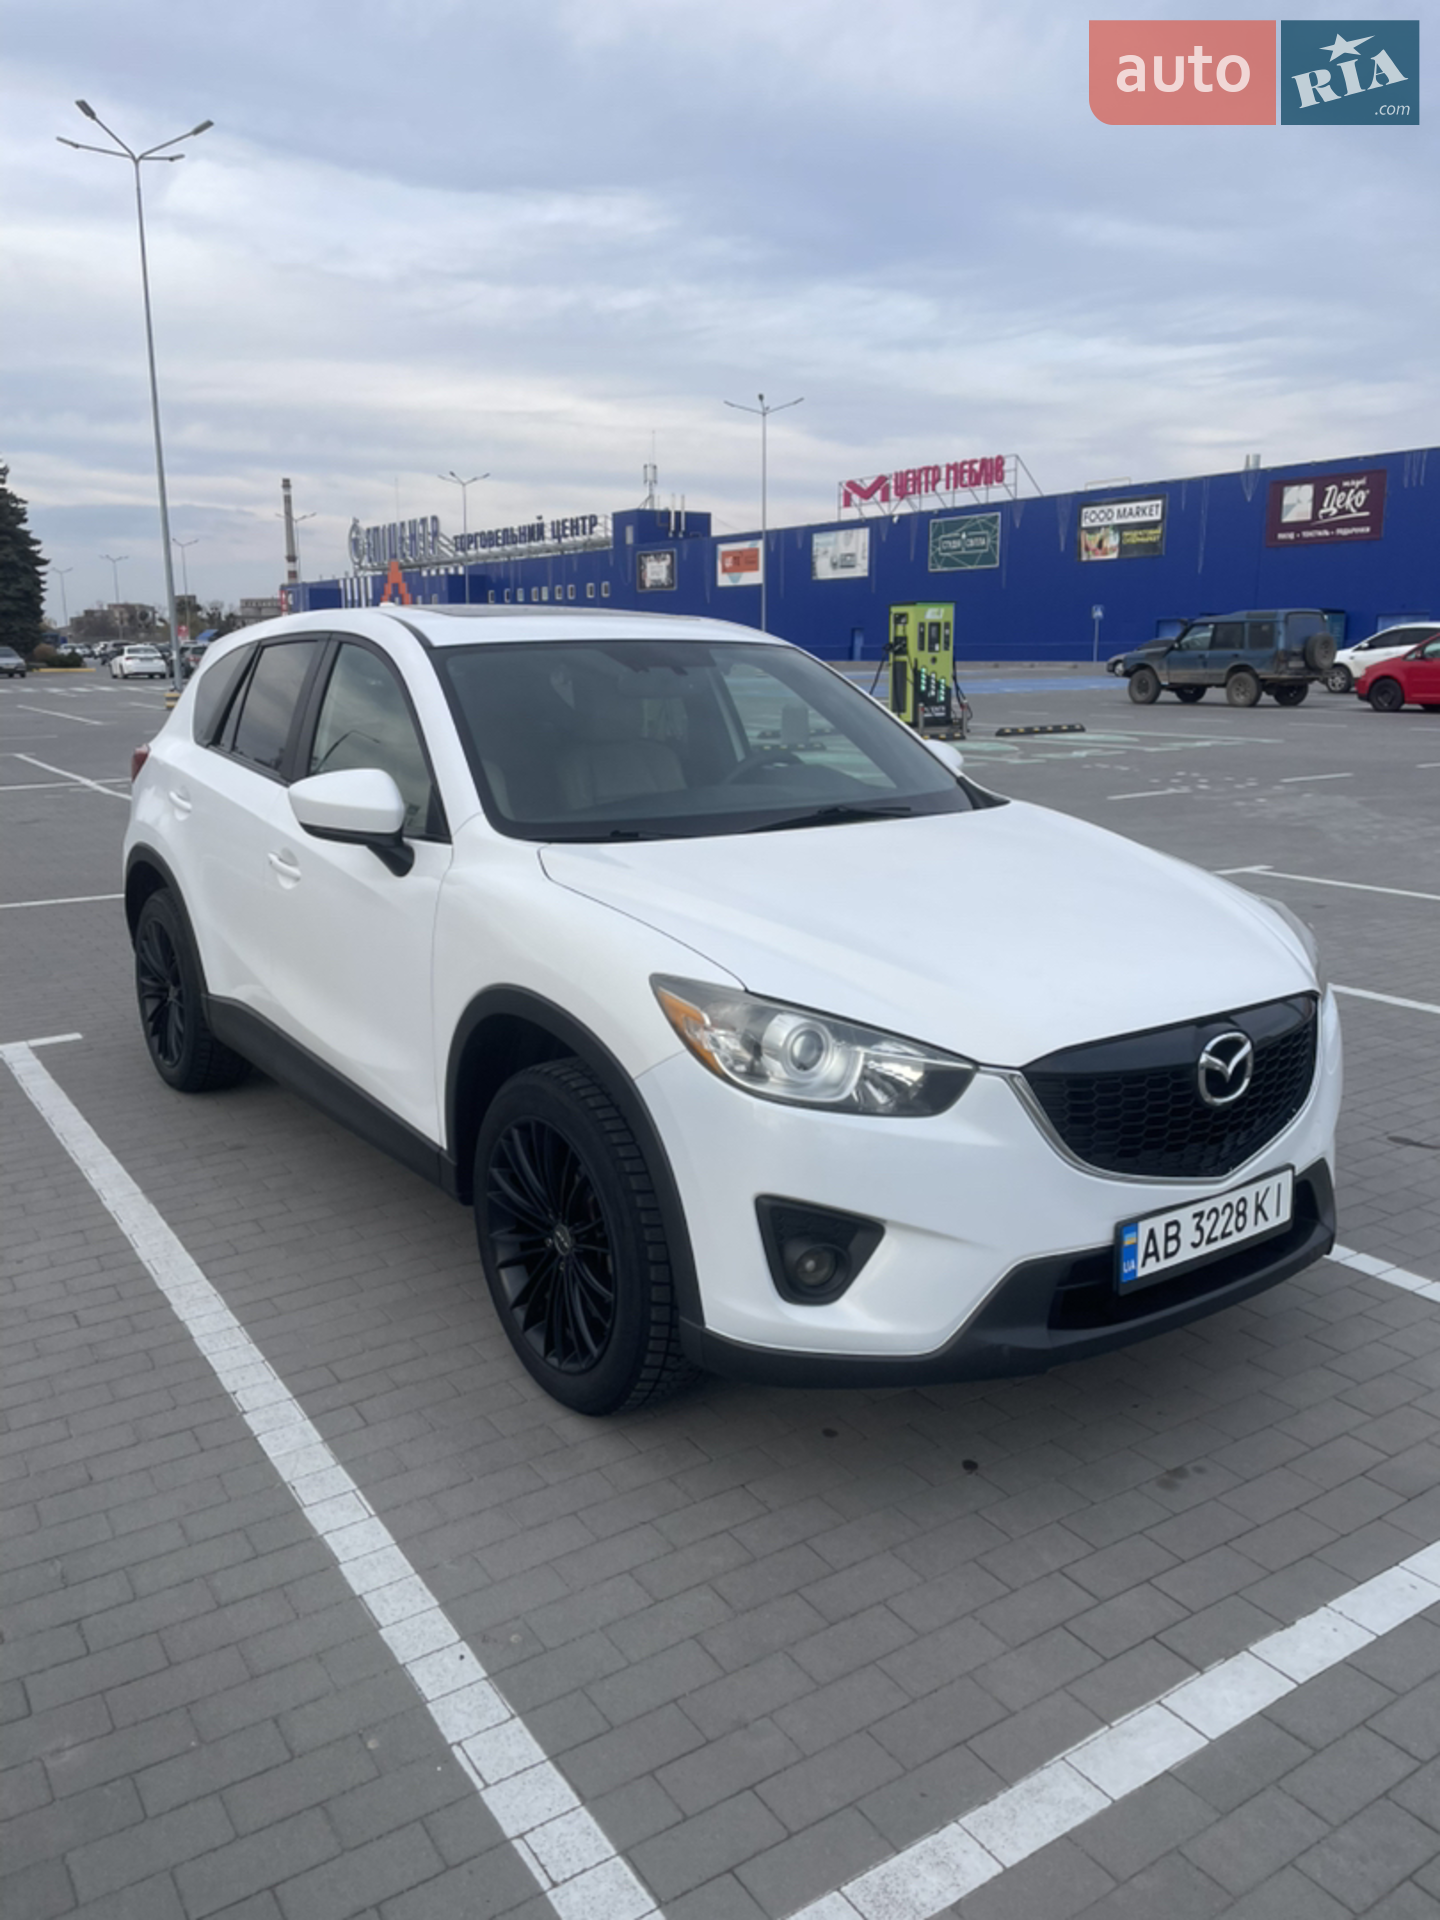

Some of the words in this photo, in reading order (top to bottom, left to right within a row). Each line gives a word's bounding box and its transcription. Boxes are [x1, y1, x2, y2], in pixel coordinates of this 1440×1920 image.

[893, 465, 941, 500] ЦЕНТР
[1084, 508, 1115, 524] FOOD
[1116, 503, 1160, 520] MARKET
[453, 515, 545, 552] ТОРГОВЕЛЬНИЙ
[551, 514, 598, 544] ЦЕНТР
[1141, 1219, 1182, 1268] AB
[1190, 1197, 1249, 1249] 3228
